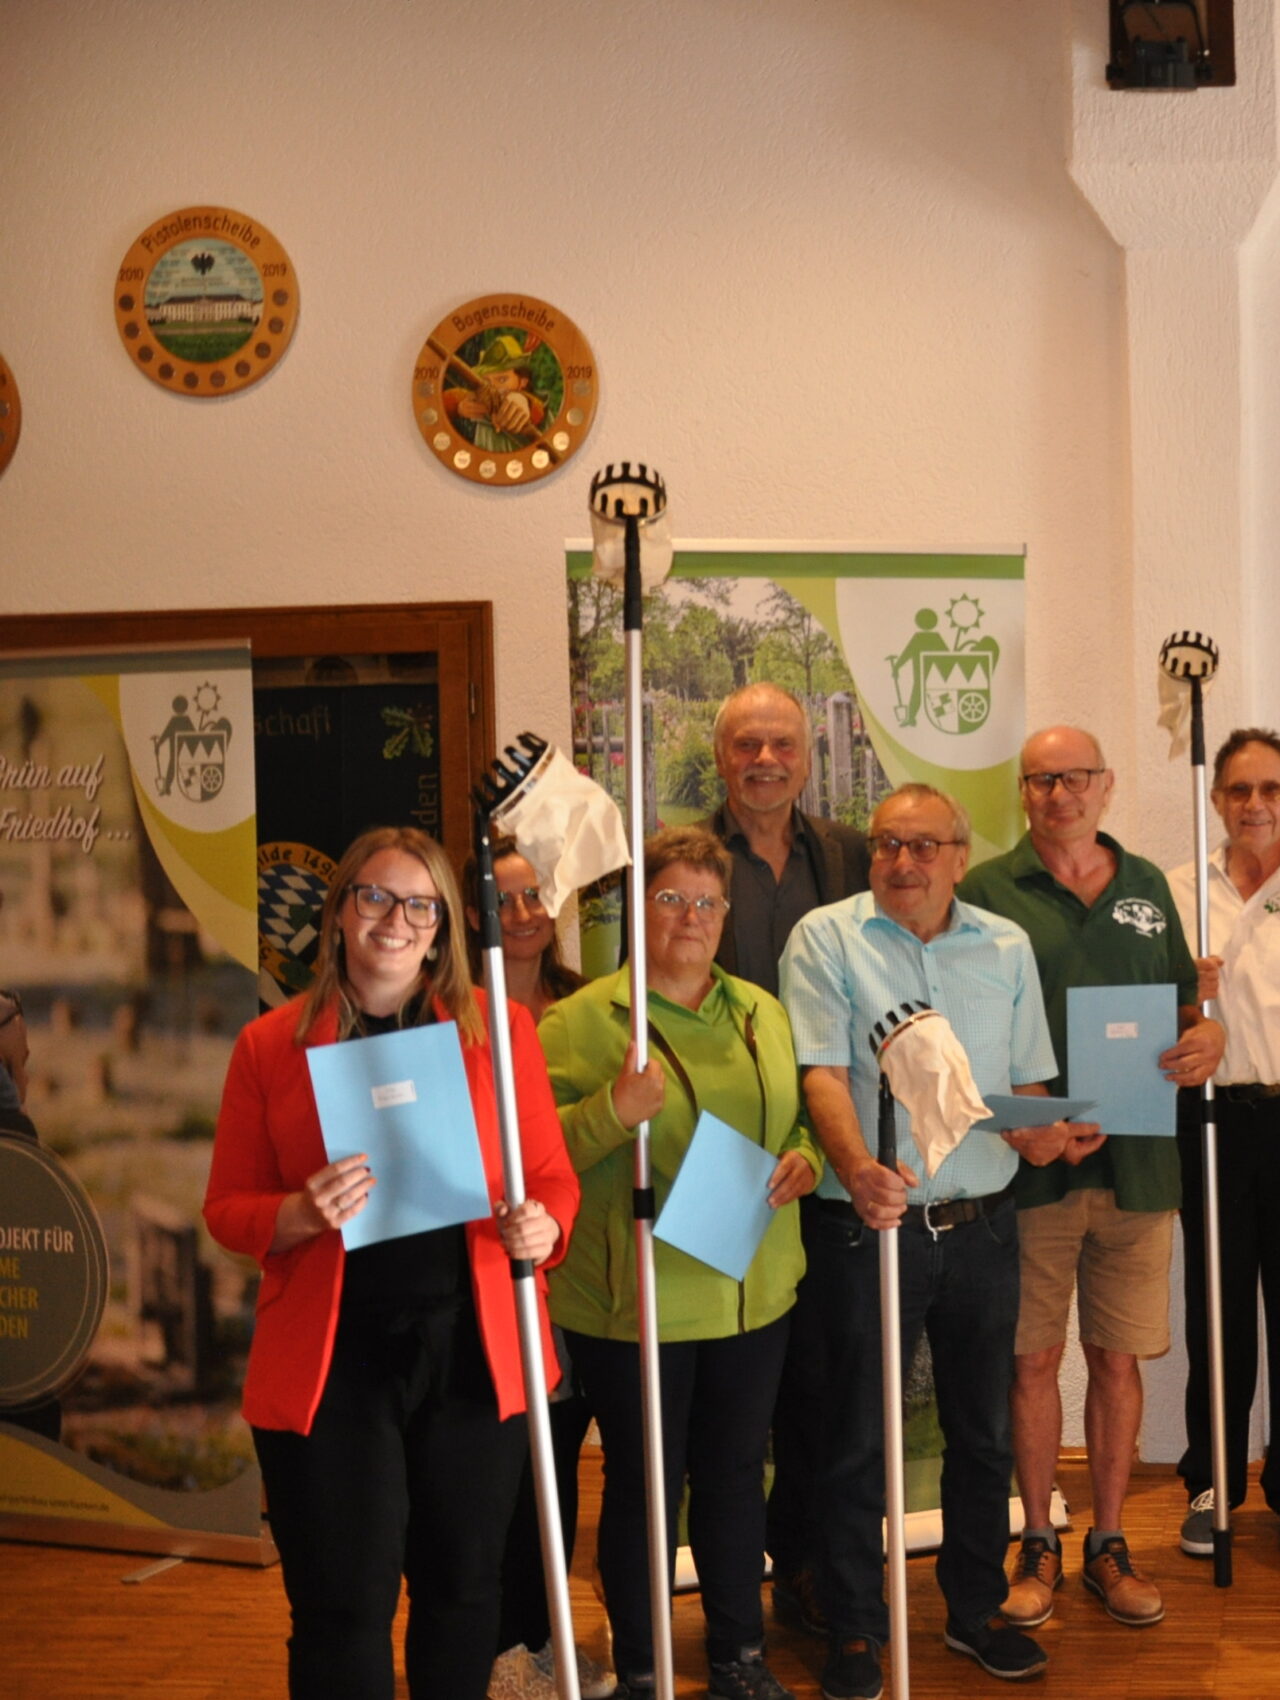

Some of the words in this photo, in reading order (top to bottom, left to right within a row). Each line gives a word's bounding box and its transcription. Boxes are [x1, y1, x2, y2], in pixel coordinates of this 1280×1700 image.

[140, 215, 261, 253] Pistolenscheibe
[119, 267, 145, 281] 2010
[262, 263, 287, 277] 2019
[451, 302, 556, 333] Bogenscheibe
[414, 366, 440, 380] 2010
[567, 366, 592, 379] 2019
[58, 752, 105, 802] auf
[410, 773, 438, 838] den
[44, 1225, 75, 1253] FÜR
